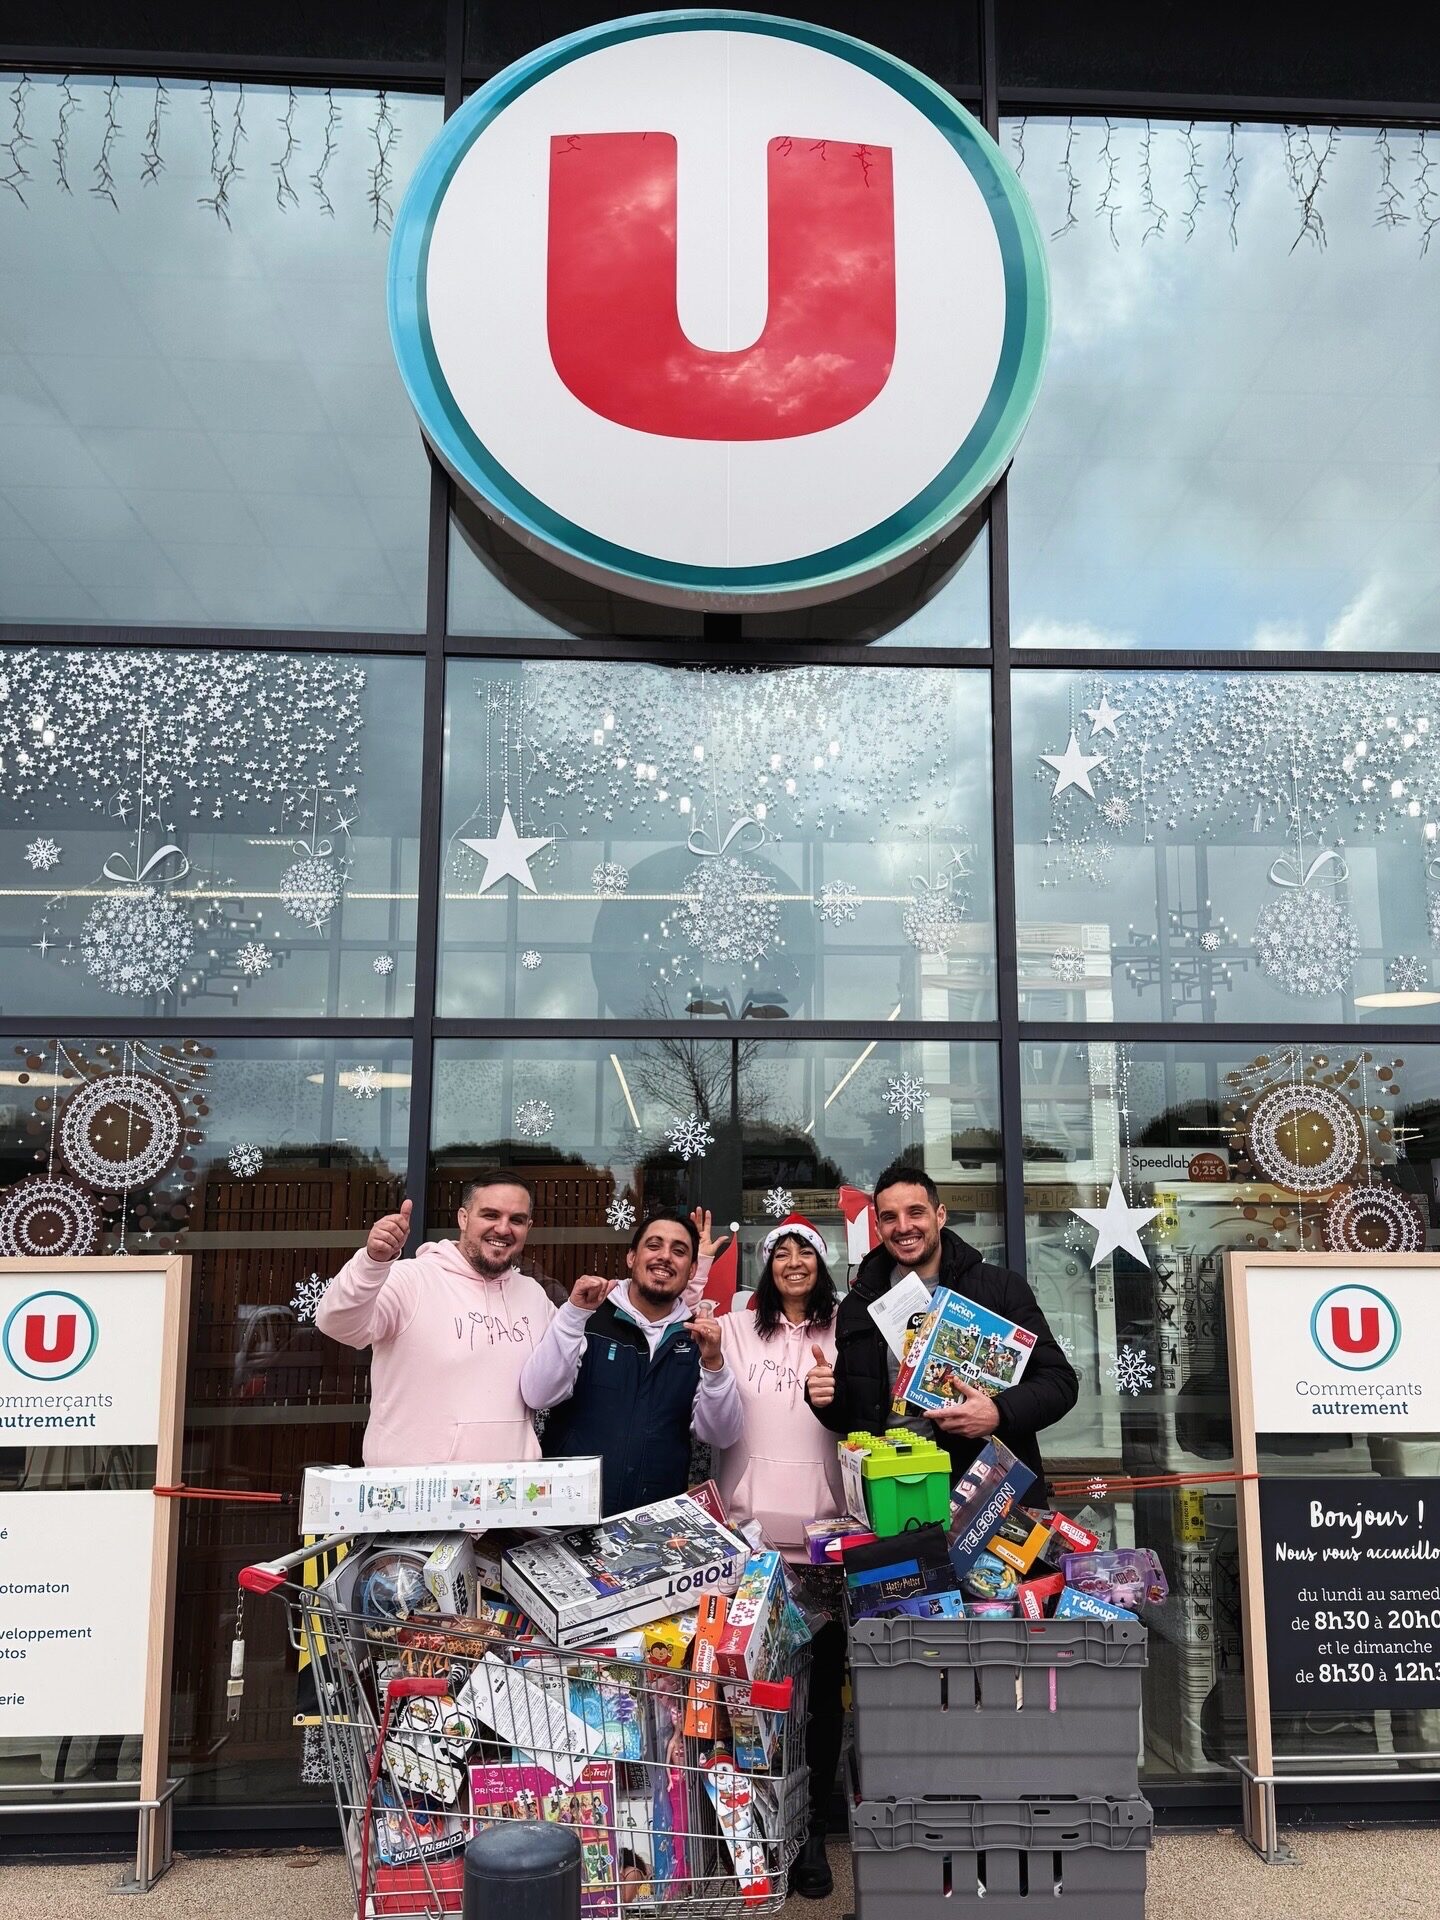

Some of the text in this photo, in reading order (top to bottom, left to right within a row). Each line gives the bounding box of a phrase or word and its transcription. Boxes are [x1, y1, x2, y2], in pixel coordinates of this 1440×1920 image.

[547, 131, 897, 441] U
[1132, 1154, 1189, 1171] Speedlab
[1192, 1166, 1223, 1177] 0,25€
[947, 1300, 976, 1320] MICKEY
[25, 1314, 77, 1364] U
[1331, 1307, 1379, 1353] U
[1295, 1380, 1422, 1400] Commerçants
[1312, 1401, 1409, 1415] autrement
[0, 1413, 96, 1428] utrement
[958, 1482, 1016, 1554] TELECRAN
[1310, 1500, 1424, 1539] Bonjour !
[1275, 1539, 1440, 1562] Nous vous accueillo
[665, 1560, 733, 1598] ROBOT
[1297, 1586, 1440, 1602] du lundi au samed
[1071, 1595, 1119, 1621] T'choupi
[1291, 1609, 1440, 1631] de 8h30 à 20h0
[1317, 1639, 1433, 1655] et le dimanche
[1295, 1669, 1314, 1683] de
[1319, 1662, 1374, 1683] 8h30
[1378, 1668, 1388, 1682] à
